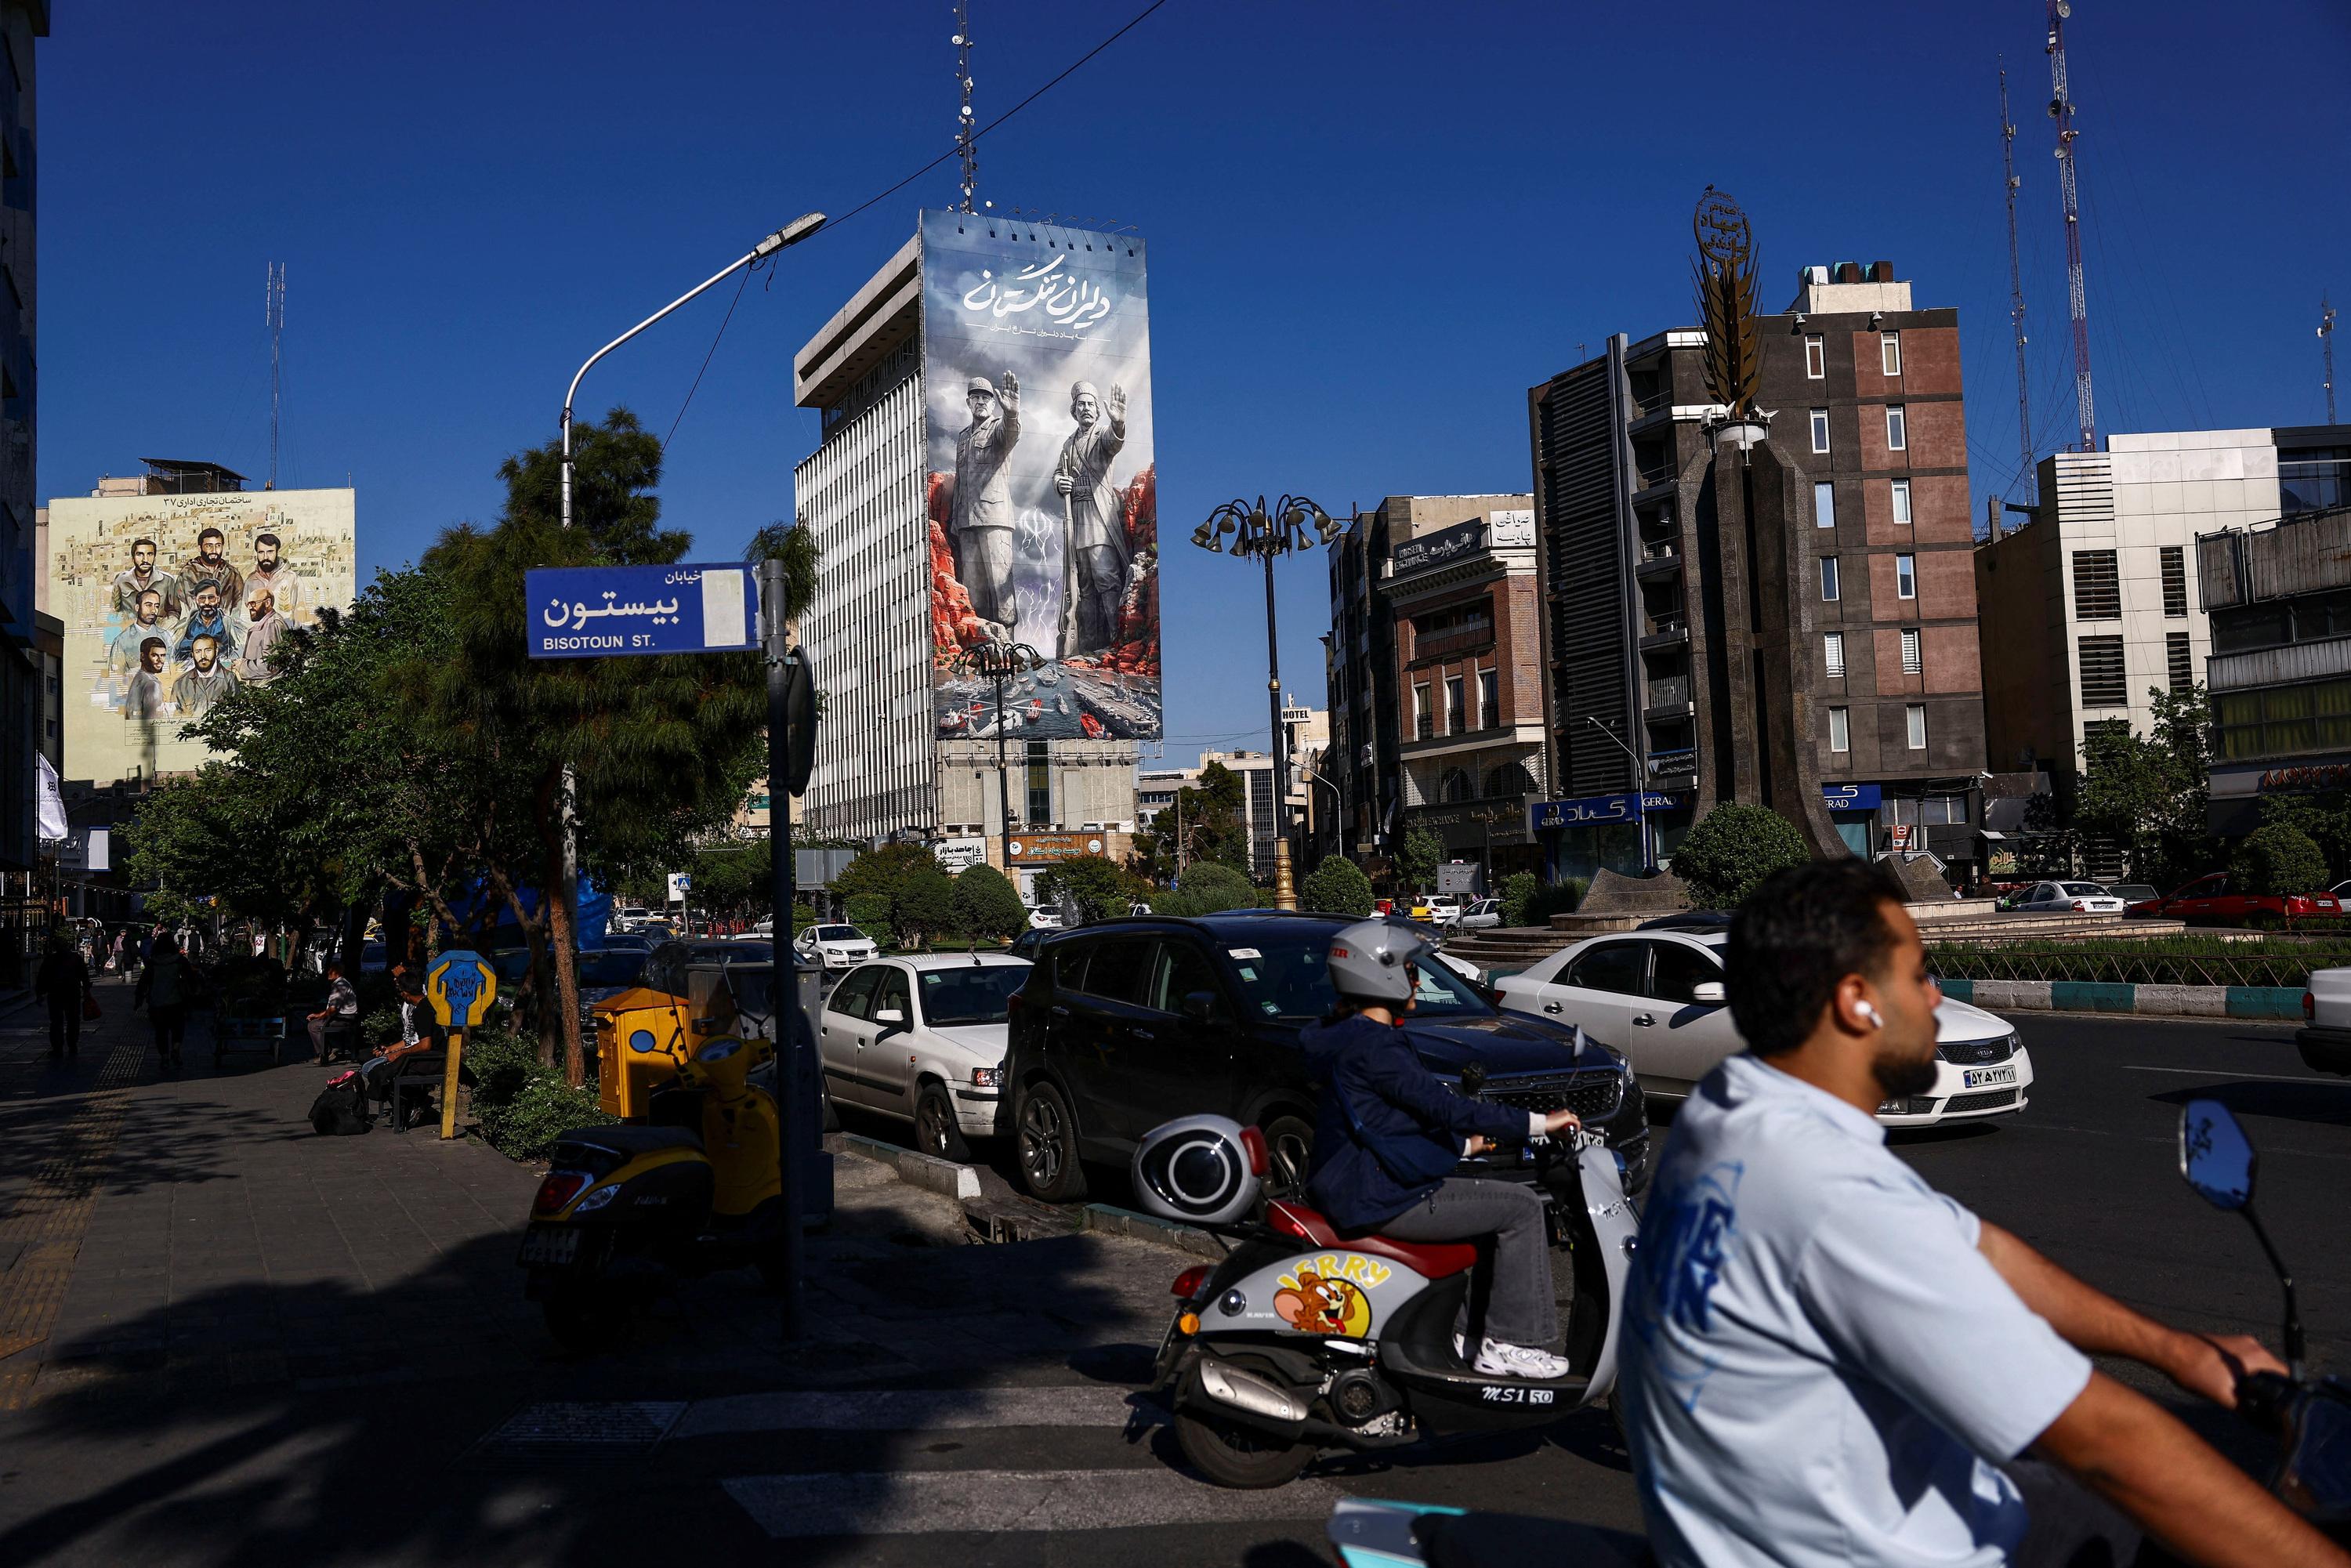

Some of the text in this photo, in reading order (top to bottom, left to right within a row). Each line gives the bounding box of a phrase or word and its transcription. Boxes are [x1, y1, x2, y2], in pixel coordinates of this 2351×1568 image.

[963, 254, 1110, 329] دلیران تنگستان
[990, 324, 1012, 333] ایران
[1037, 327, 1059, 339] دلیران
[176, 497, 196, 508] اداری
[197, 497, 218, 507] تجاری
[219, 496, 252, 507] ساختمان
[1496, 512, 1530, 527] صرافی
[1497, 531, 1531, 546] پارسه
[665, 570, 702, 585] خیابان
[543, 590, 679, 631] بیستون
[543, 634, 656, 650] BISOTOUN ST.
[1282, 710, 1310, 719] HOTEL
[1643, 797, 1677, 807] GERAD
[940, 846, 973, 856] جاهد بازار
[1027, 846, 1048, 856] استقلال
[1049, 847, 1063, 856] جهاد
